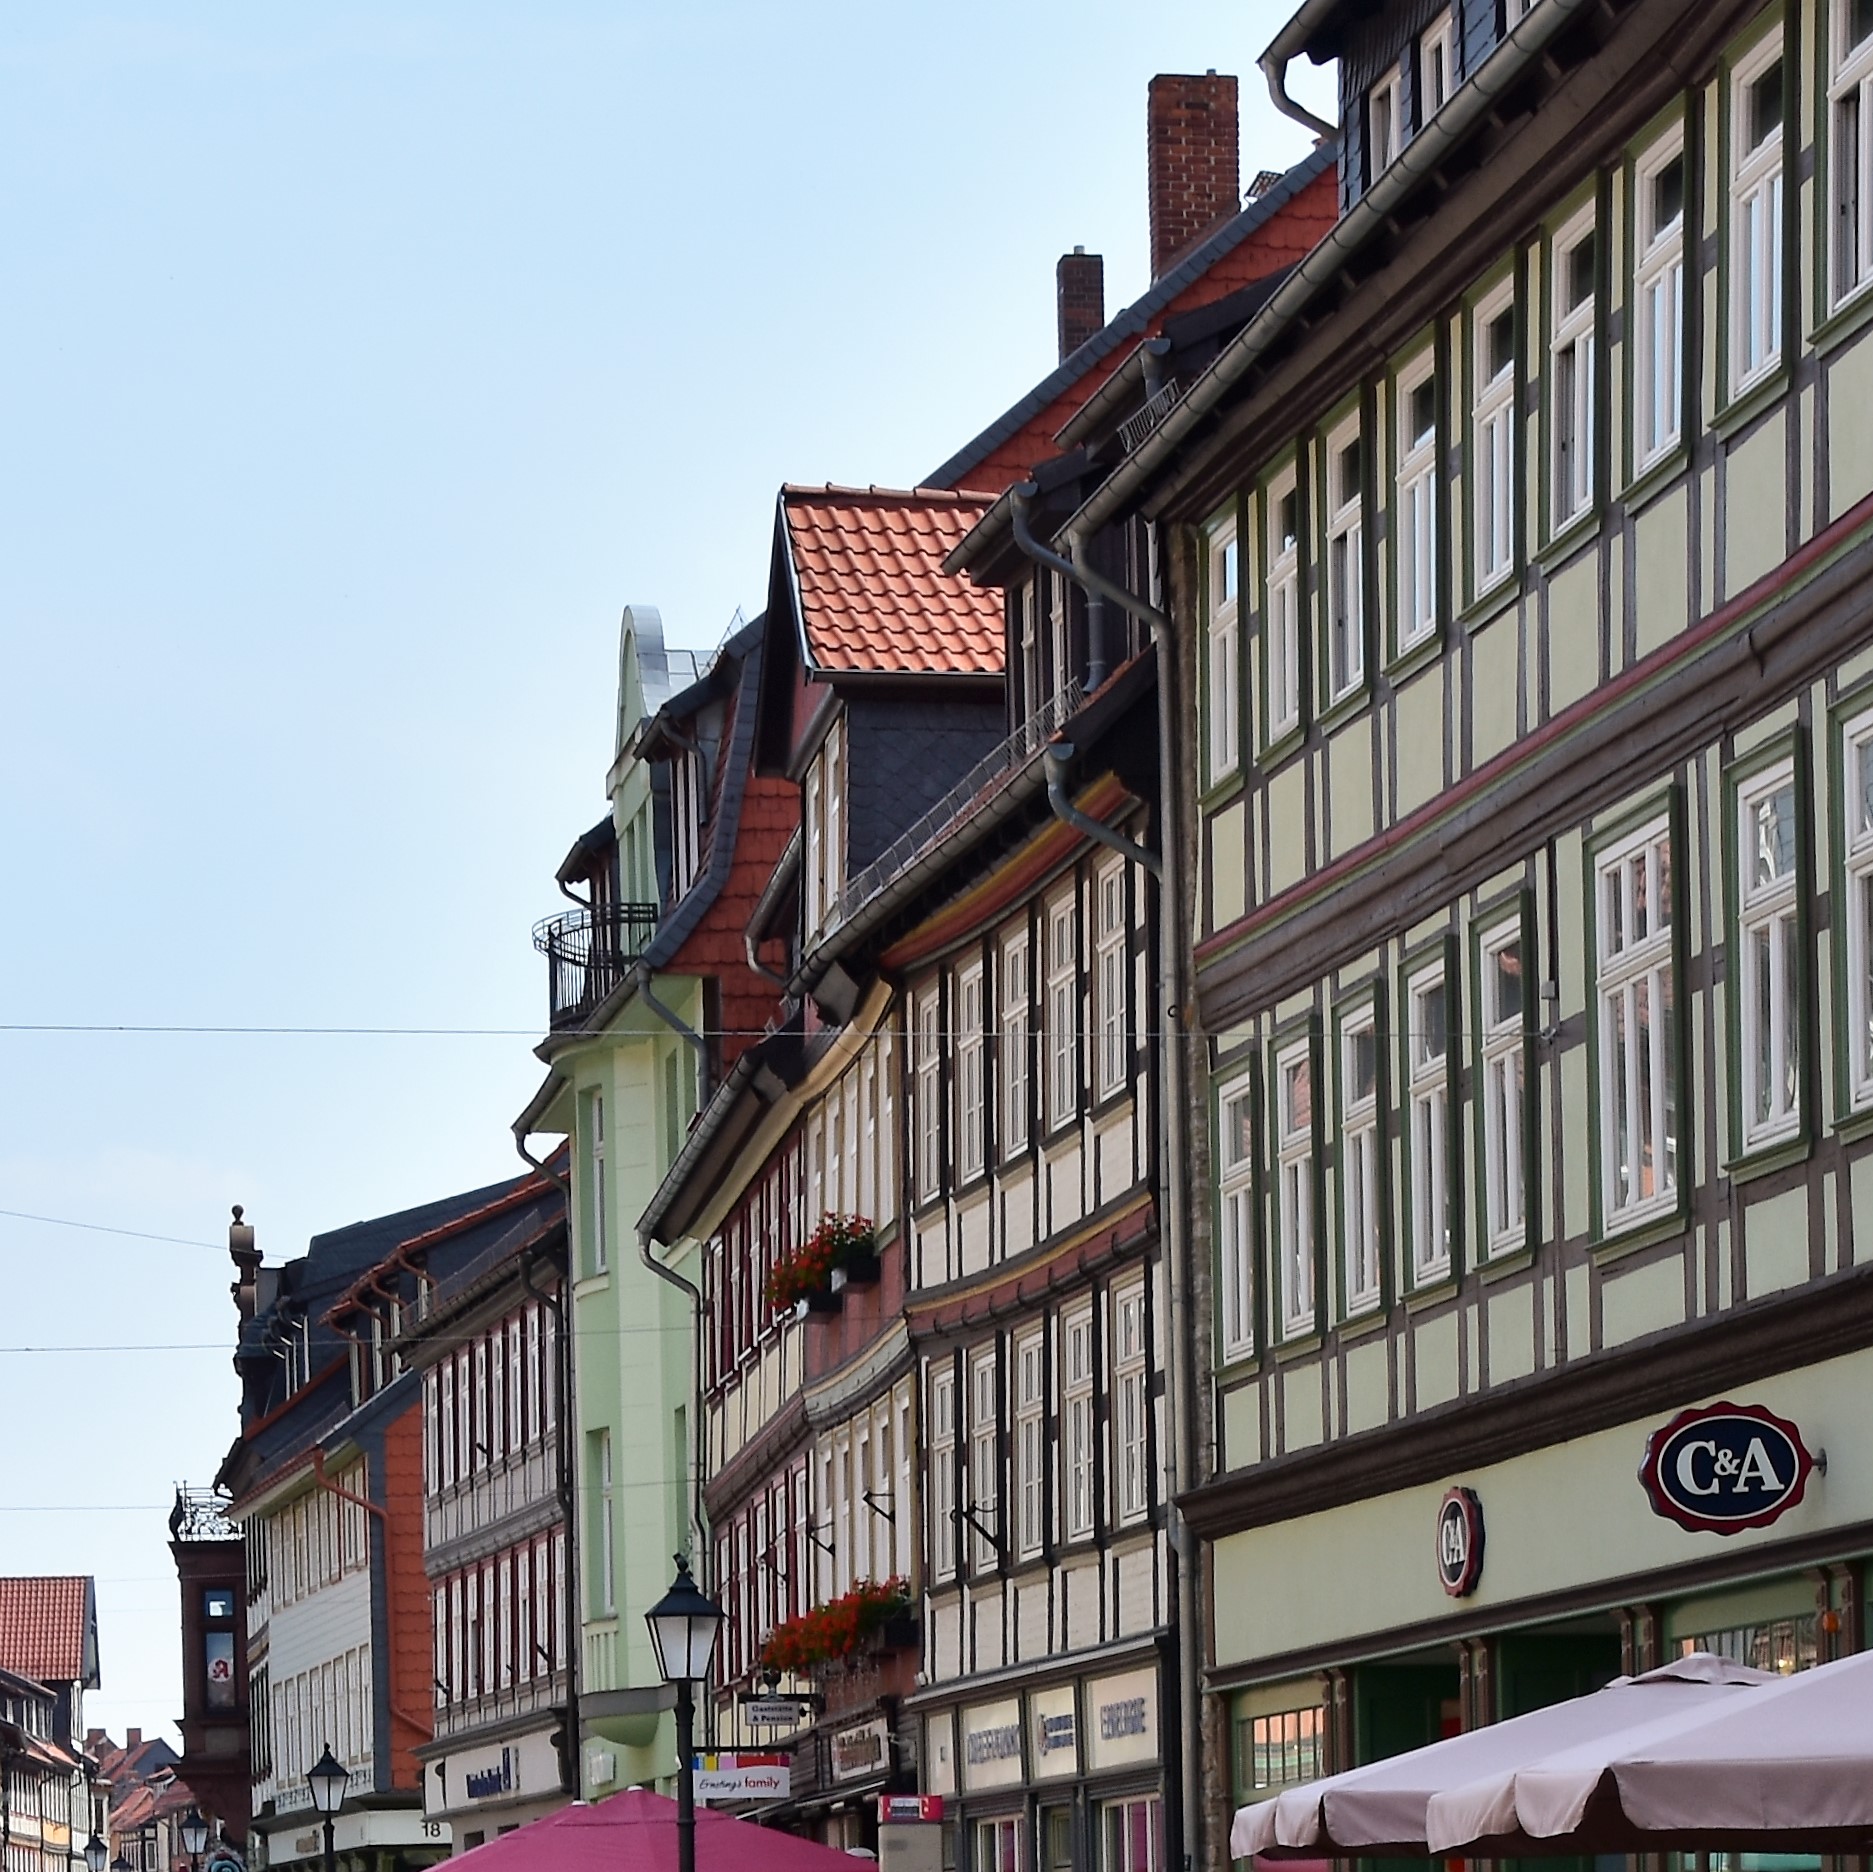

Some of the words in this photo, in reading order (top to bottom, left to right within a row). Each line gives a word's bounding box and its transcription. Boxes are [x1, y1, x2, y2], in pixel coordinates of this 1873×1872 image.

[1676, 1436, 1785, 1497] C&A
[1441, 1514, 1466, 1567] C&A
[752, 1714, 759, 1722] &
[761, 1714, 793, 1722] Pension
[744, 1775, 780, 1790] family
[422, 1821, 441, 1838] 18
